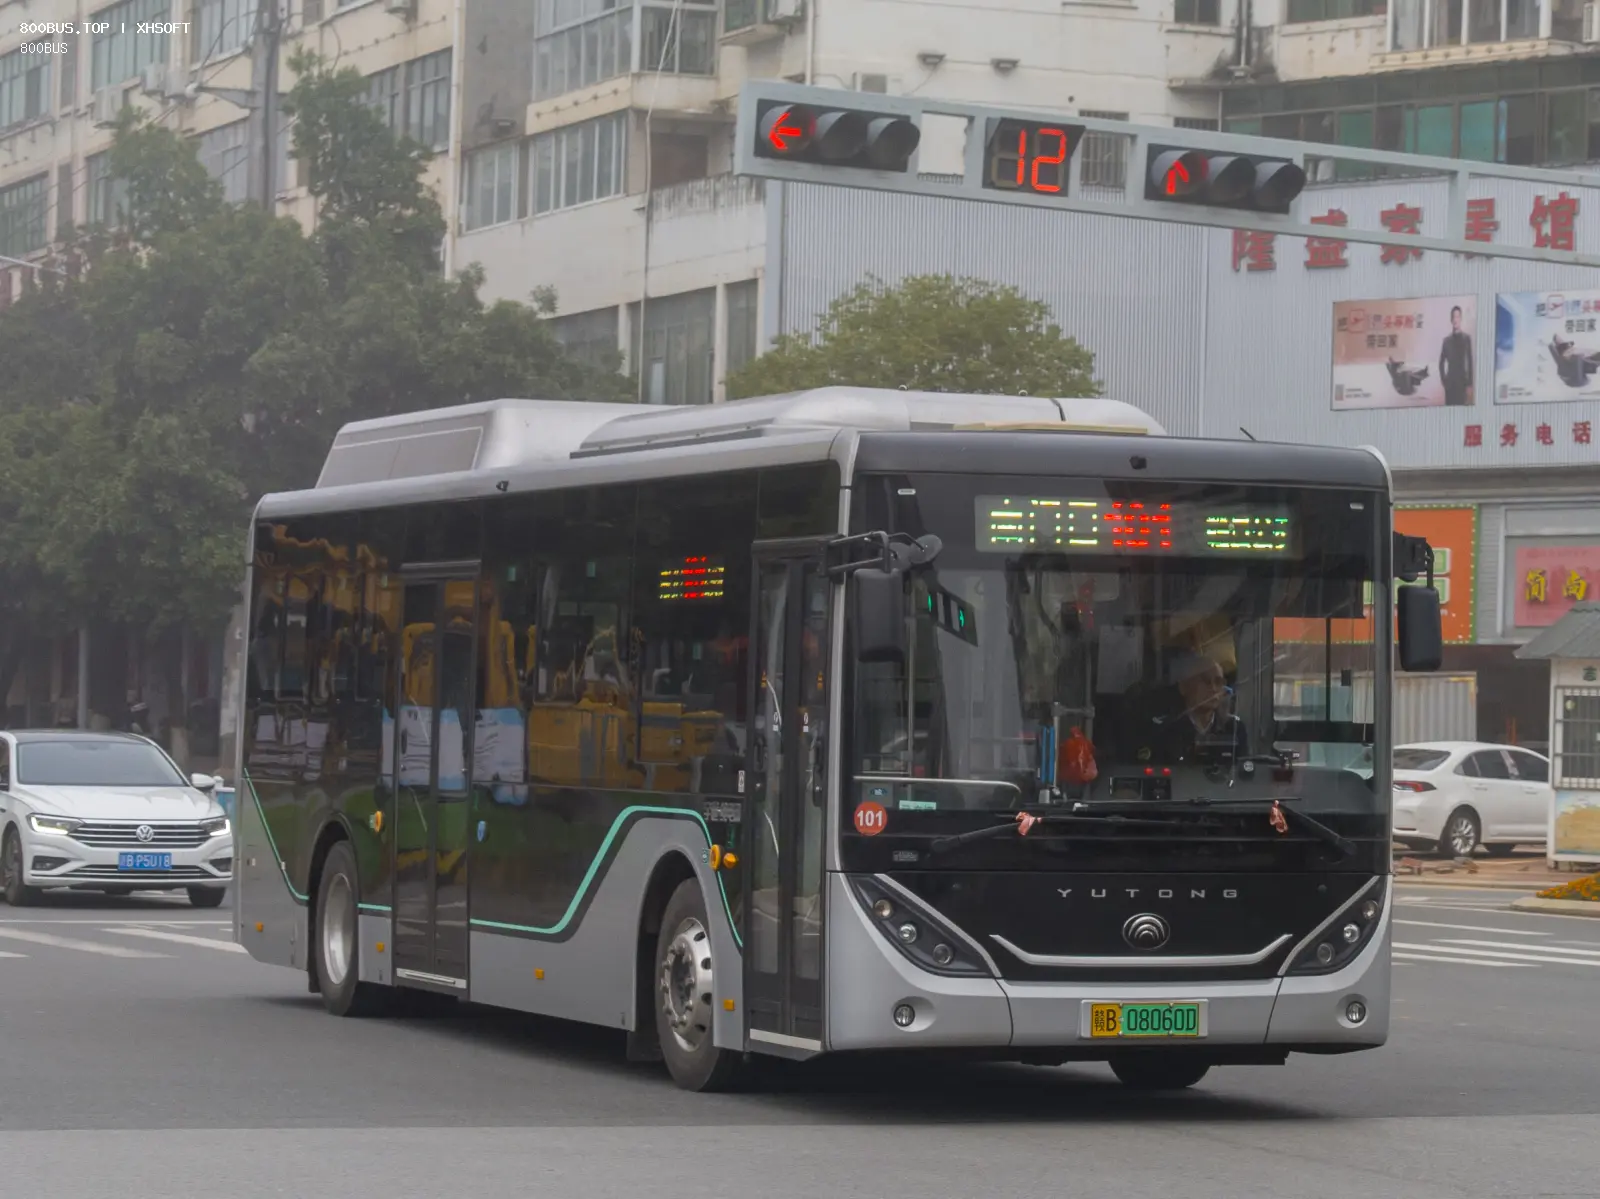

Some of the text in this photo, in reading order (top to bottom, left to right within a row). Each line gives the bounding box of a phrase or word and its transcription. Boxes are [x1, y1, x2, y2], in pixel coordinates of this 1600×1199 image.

[1014, 129, 1067, 193] 12
[1463, 421, 1591, 447] 服务电话
[857, 810, 883, 827] 101
[1057, 888, 1238, 898] YUTONG
[1127, 1008, 1197, 1031] 08060D
